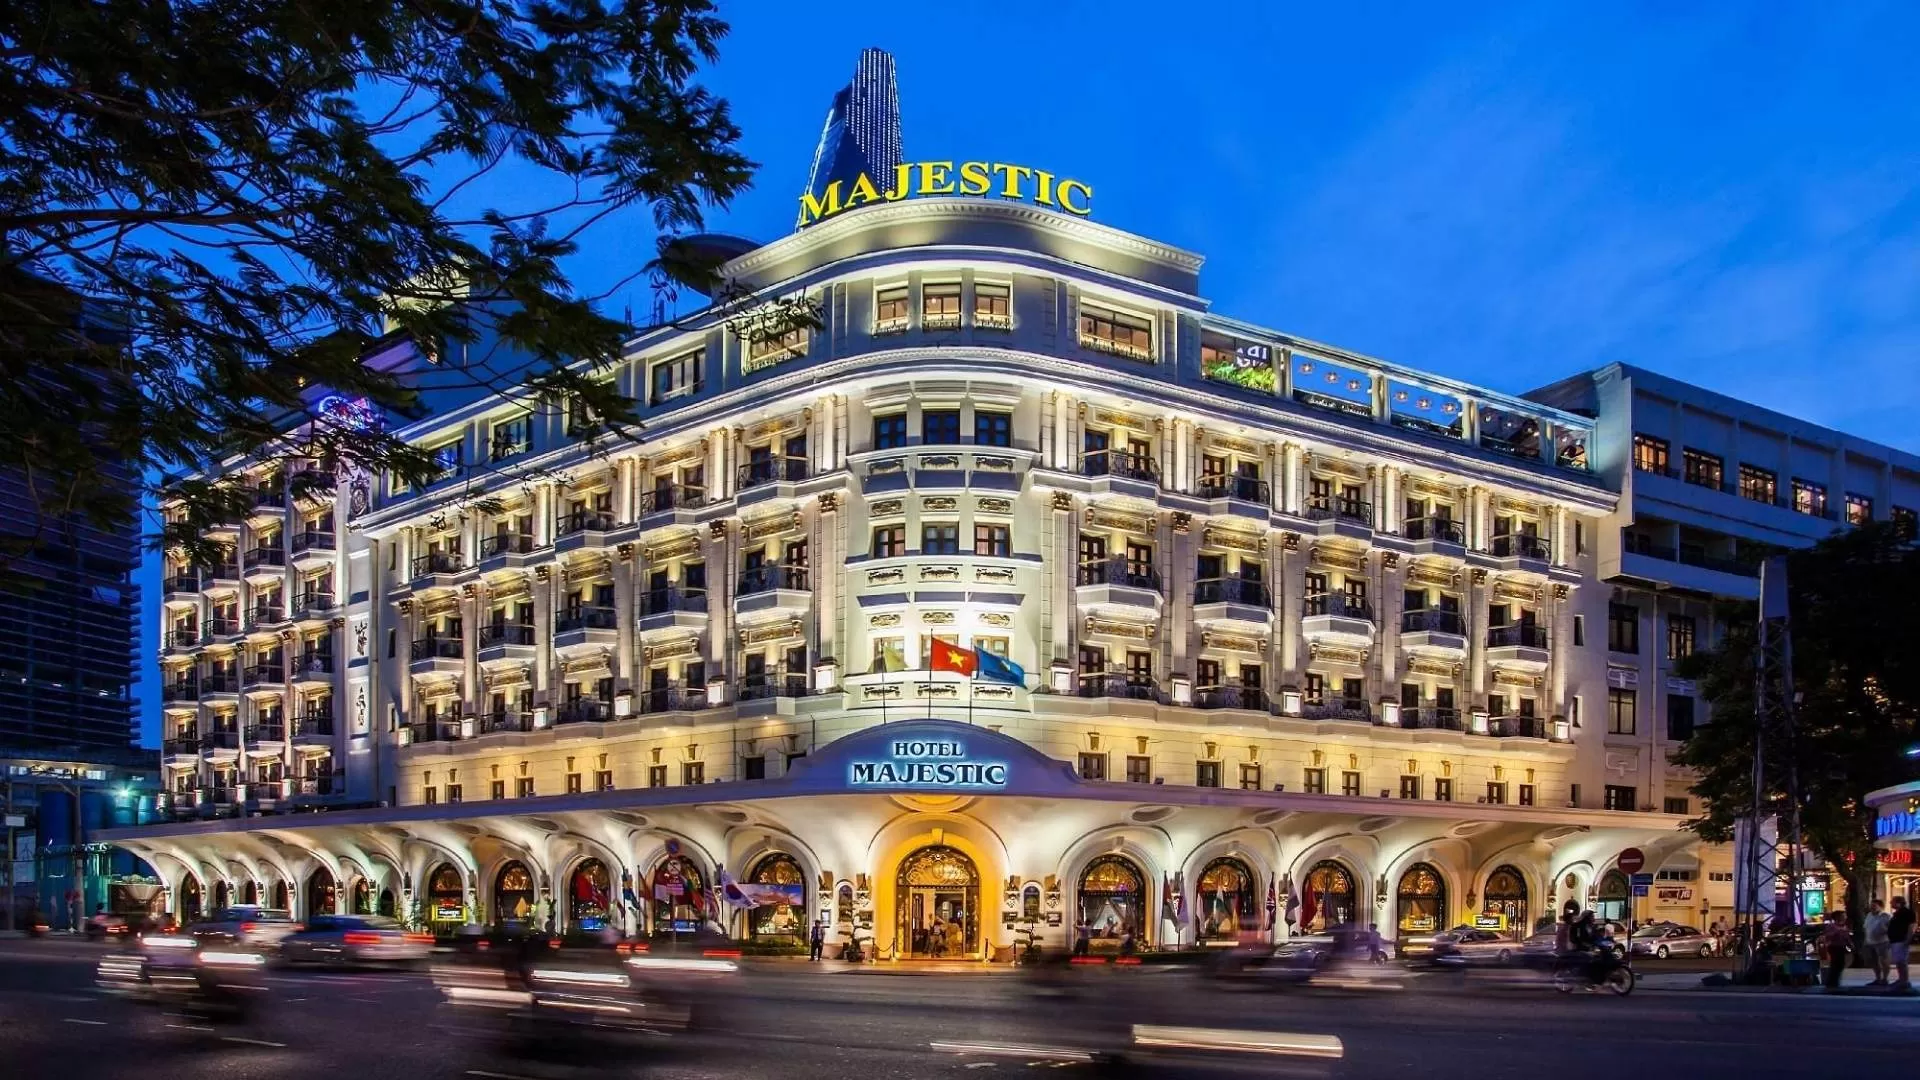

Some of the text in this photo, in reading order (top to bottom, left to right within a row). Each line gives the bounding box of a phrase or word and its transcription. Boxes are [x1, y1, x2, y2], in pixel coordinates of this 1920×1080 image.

[799, 160, 1092, 226] MAJESTIC
[895, 742, 964, 757] HOTEL
[852, 763, 1006, 785] MAJESTIC
